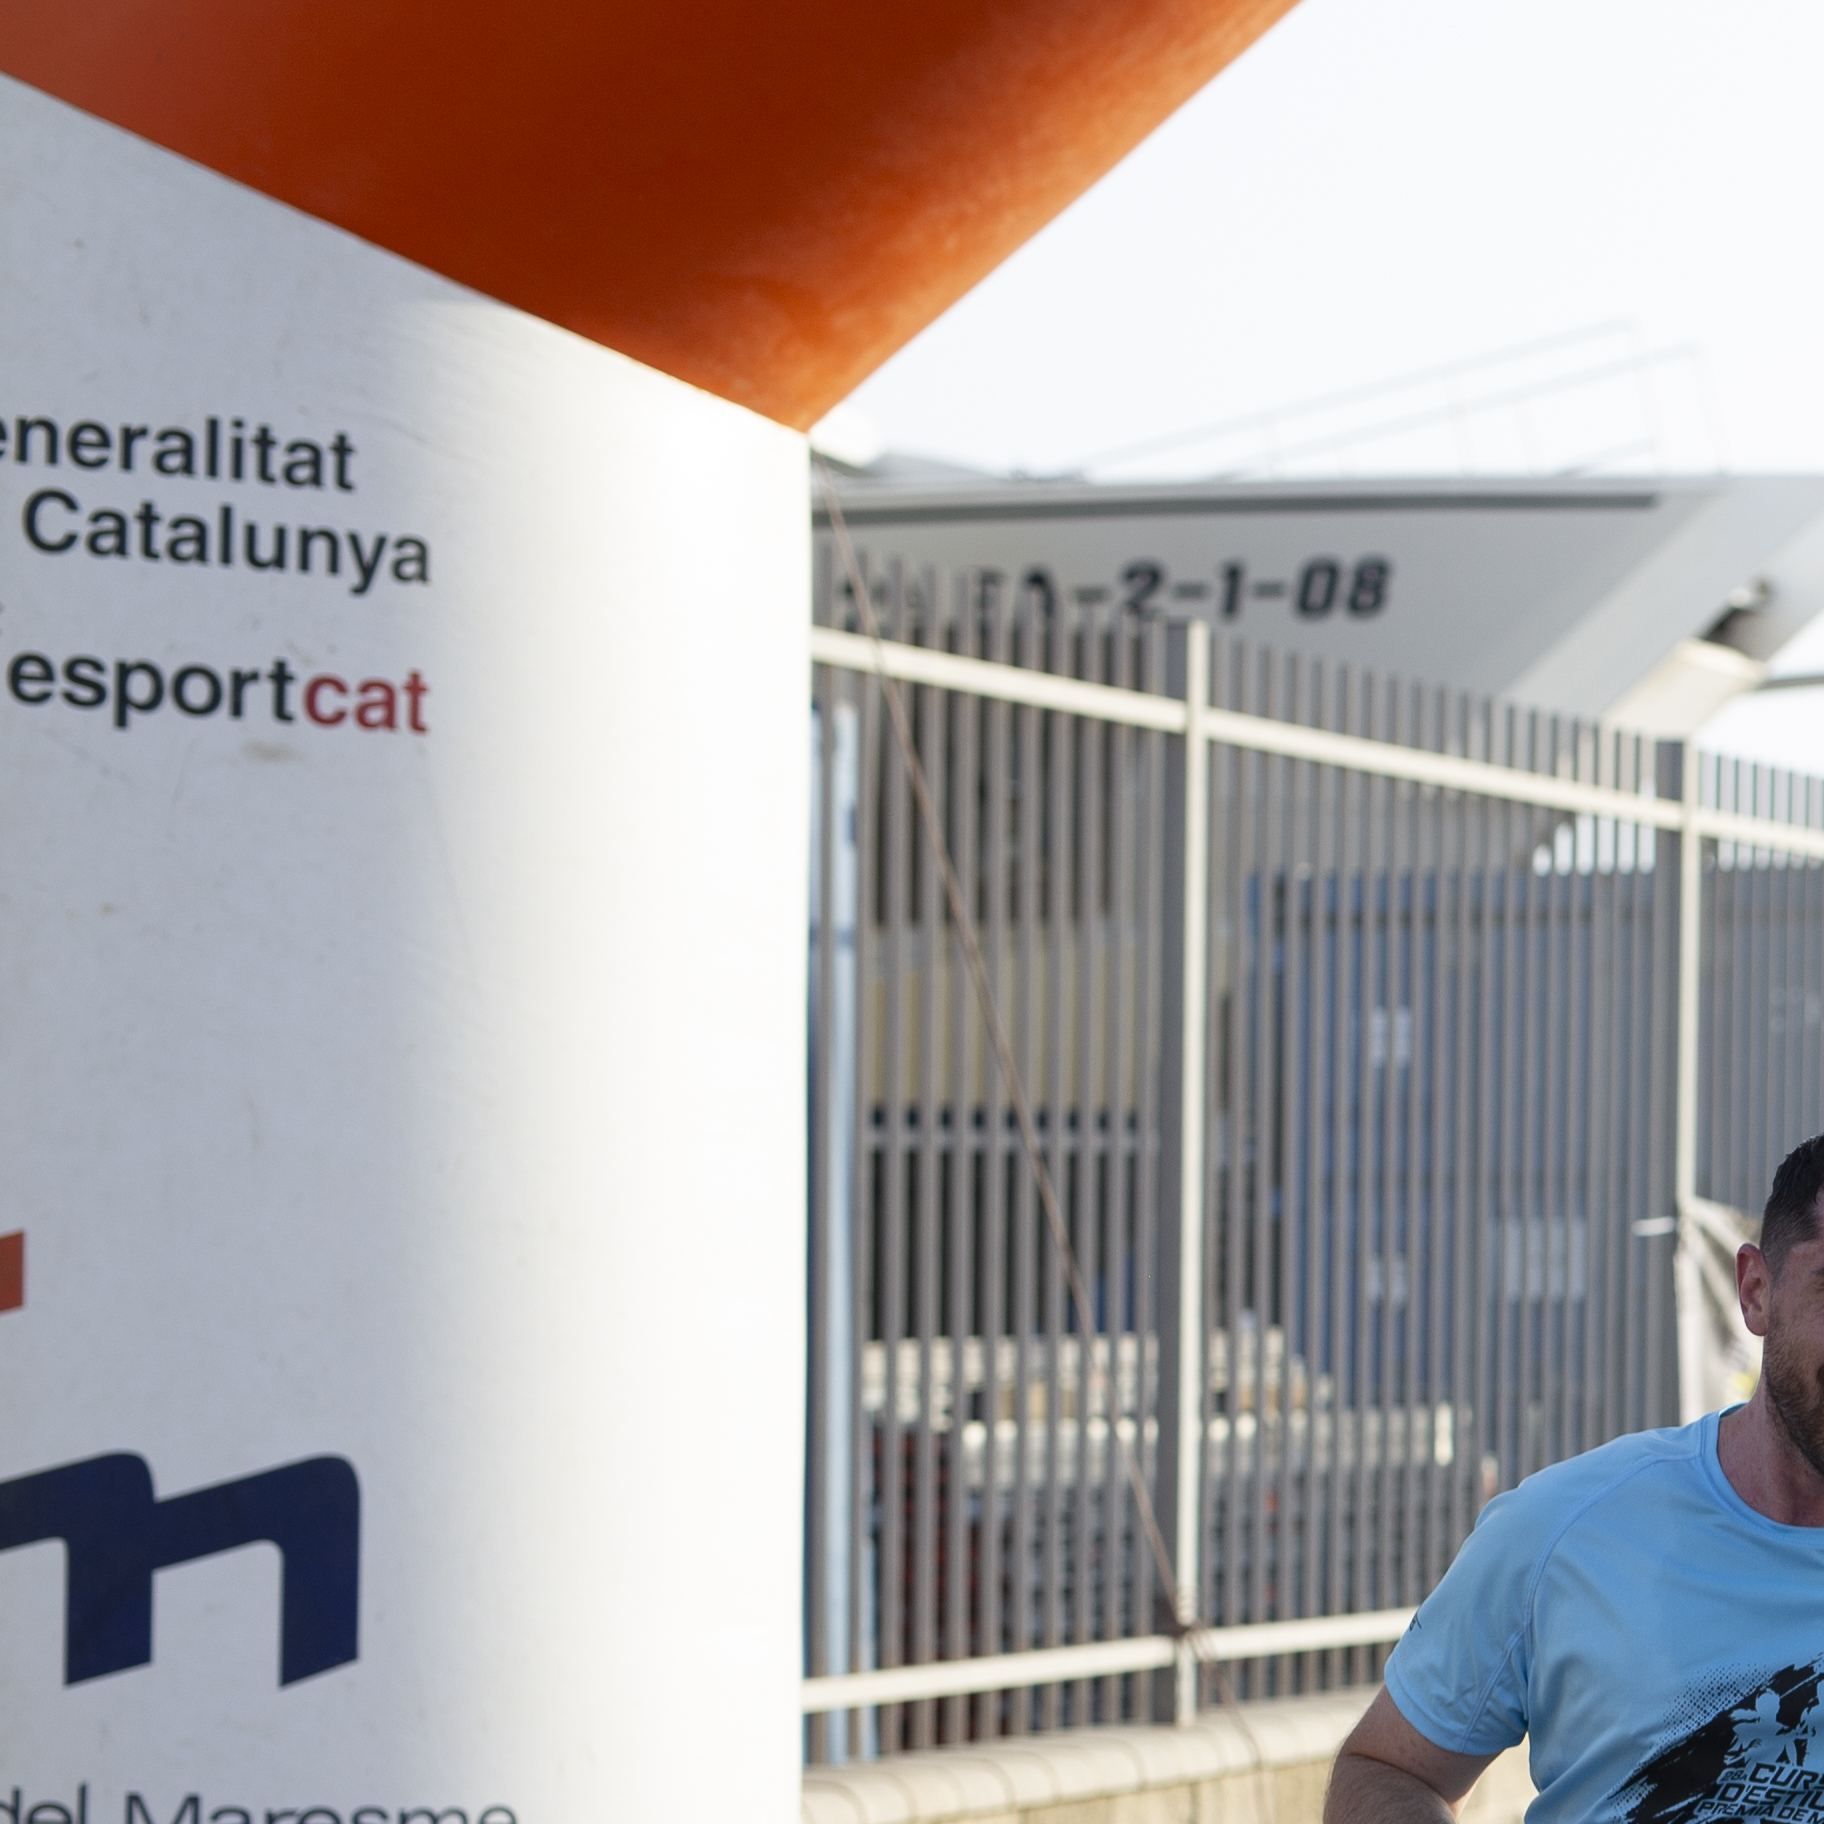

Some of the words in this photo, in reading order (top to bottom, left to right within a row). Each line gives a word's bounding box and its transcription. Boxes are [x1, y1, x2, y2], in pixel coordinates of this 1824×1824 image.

[0, 414, 356, 491] neralitat
[22, 486, 430, 595] Catalunya
[6, 650, 430, 734] esportcat
[1777, 1806, 1809, 1821] DE
